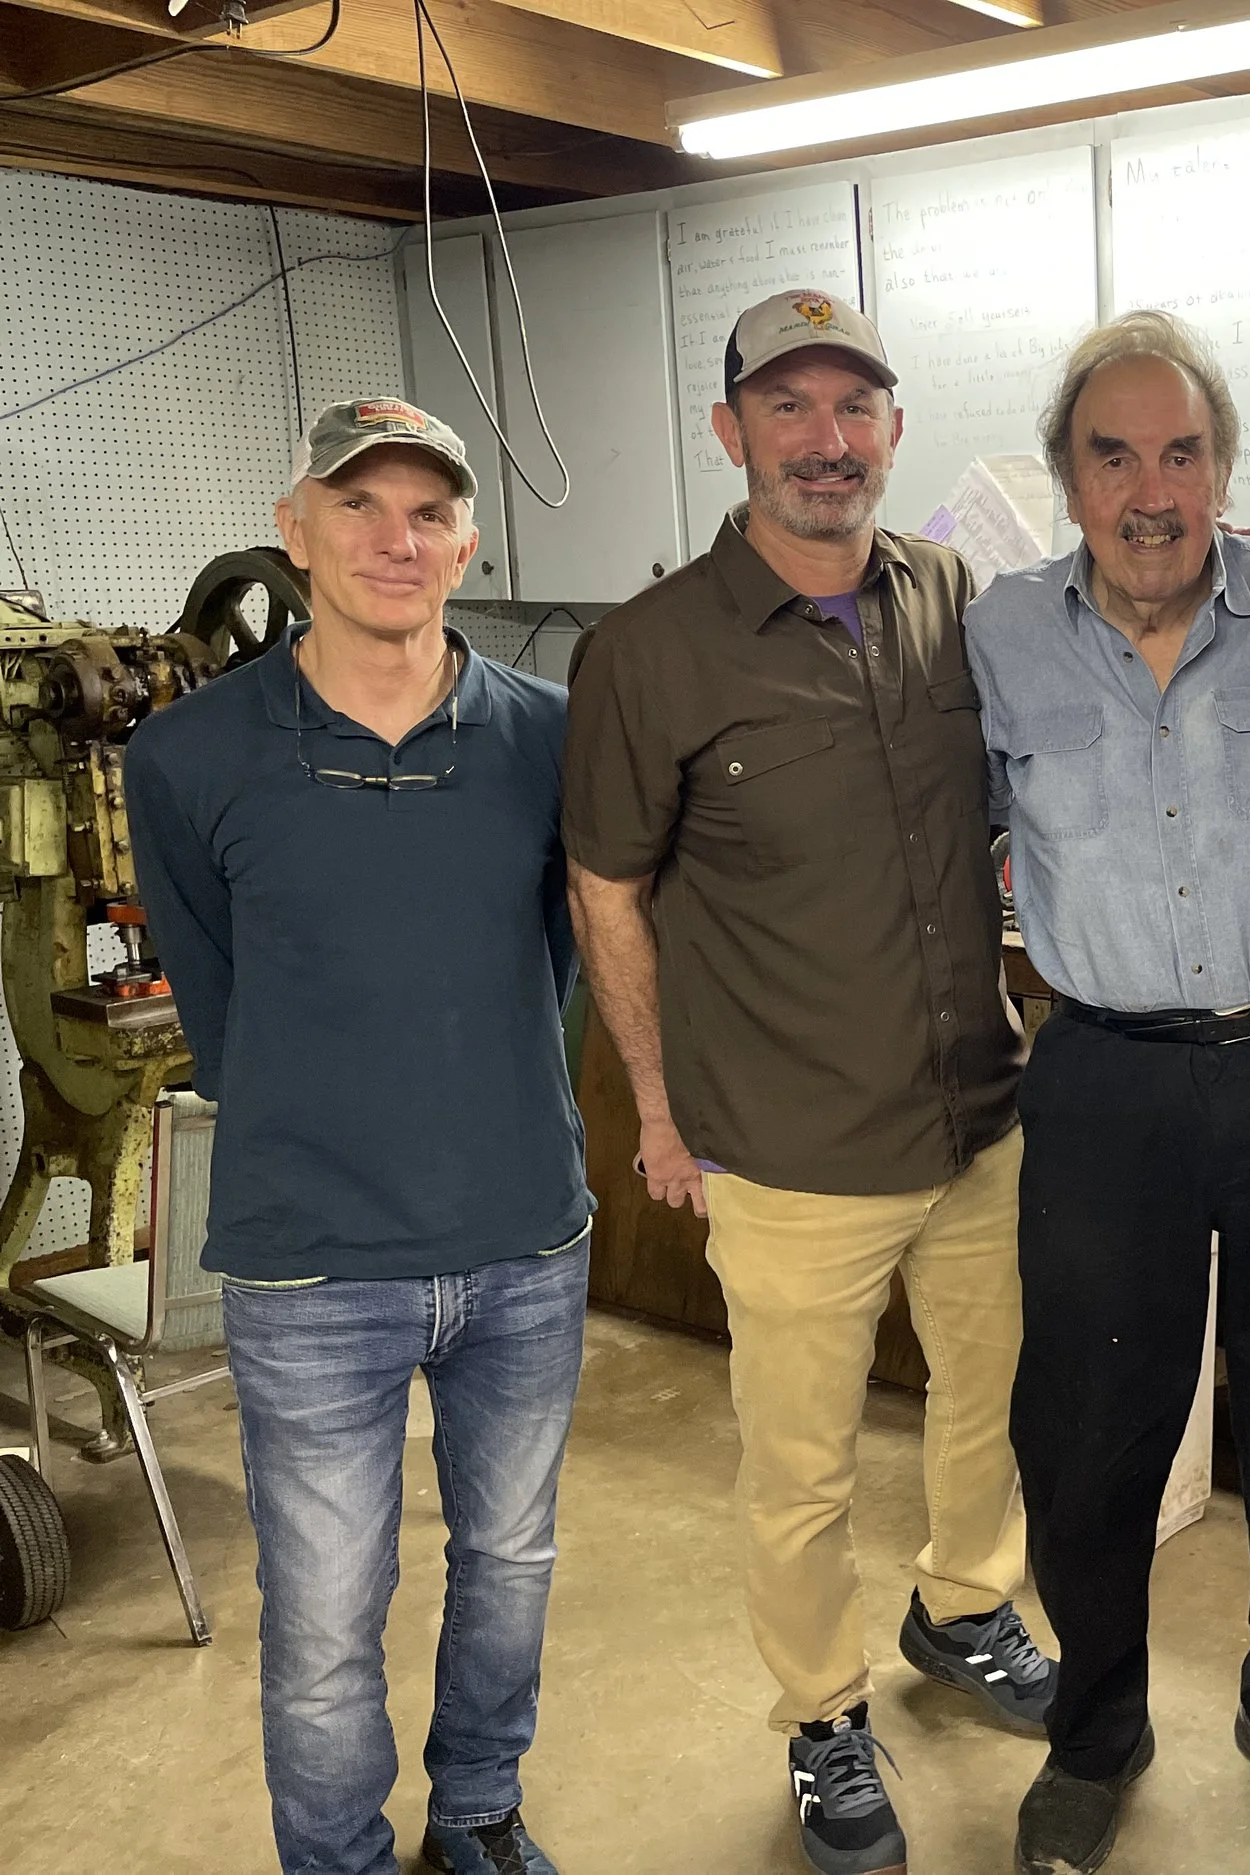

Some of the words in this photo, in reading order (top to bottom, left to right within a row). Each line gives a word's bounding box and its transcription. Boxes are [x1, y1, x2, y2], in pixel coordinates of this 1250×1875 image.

[920, 189, 970, 230] problem
[715, 215, 763, 244] grateful
[885, 271, 915, 293] also
[1232, 320, 1243, 344] I
